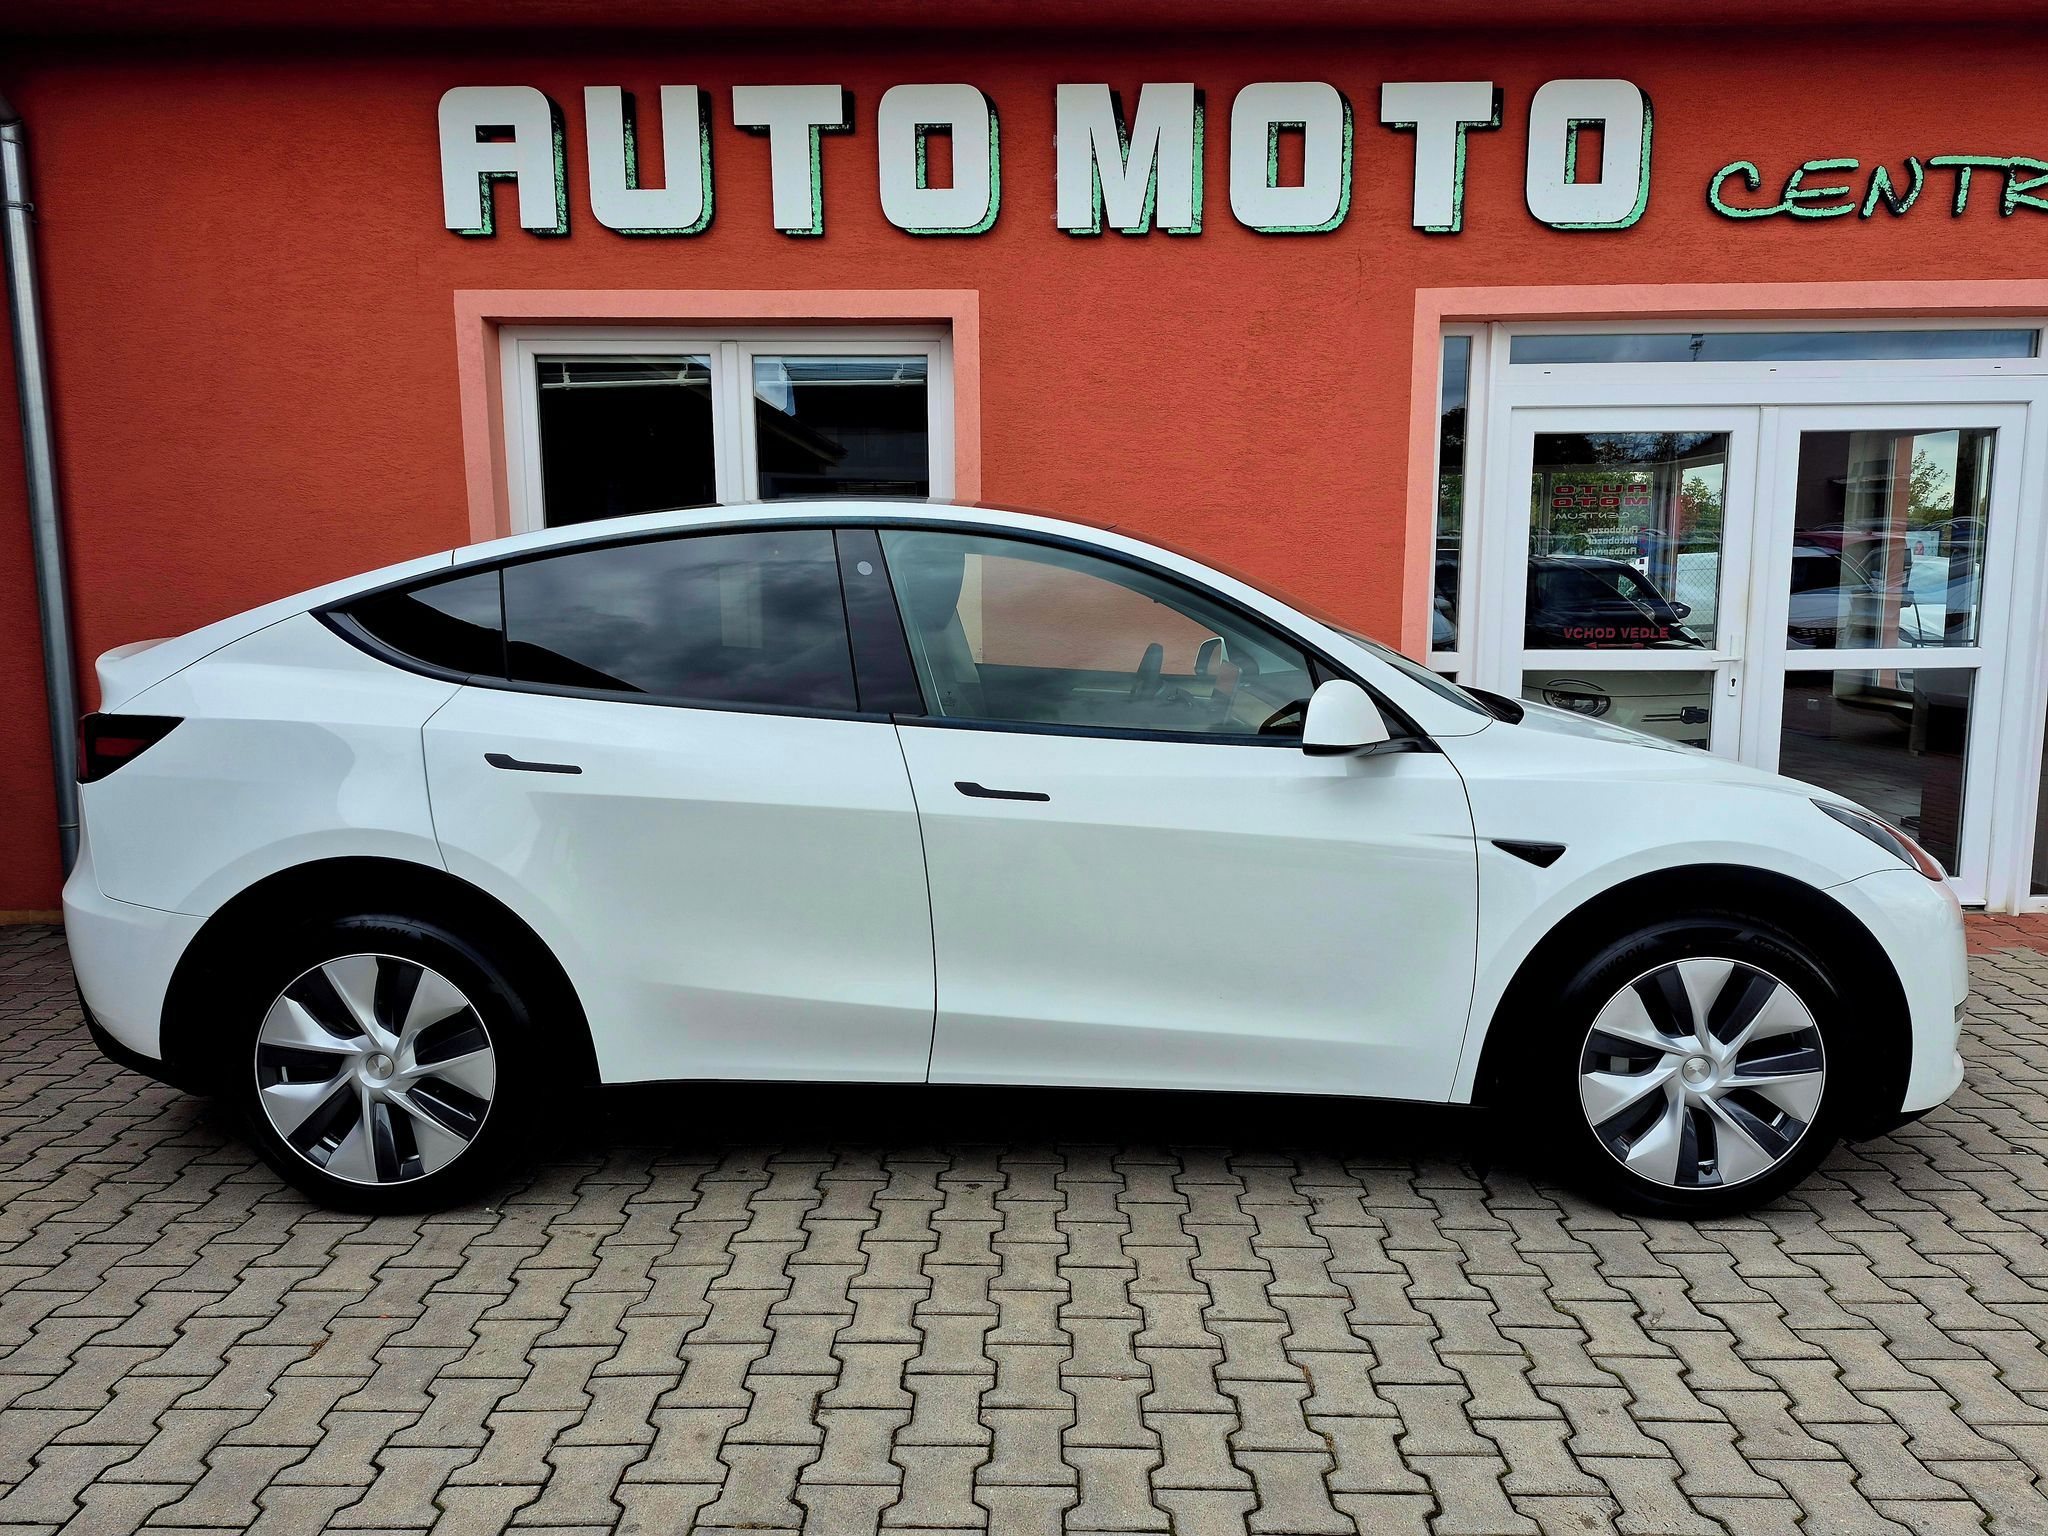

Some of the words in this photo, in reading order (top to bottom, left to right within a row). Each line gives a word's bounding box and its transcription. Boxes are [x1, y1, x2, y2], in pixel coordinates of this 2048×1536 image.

[438, 83, 999, 237] AUTO
[1056, 79, 1654, 236] MOTO
[1563, 627, 1616, 639] VCHOD
[1620, 627, 1669, 639] VEDLE
